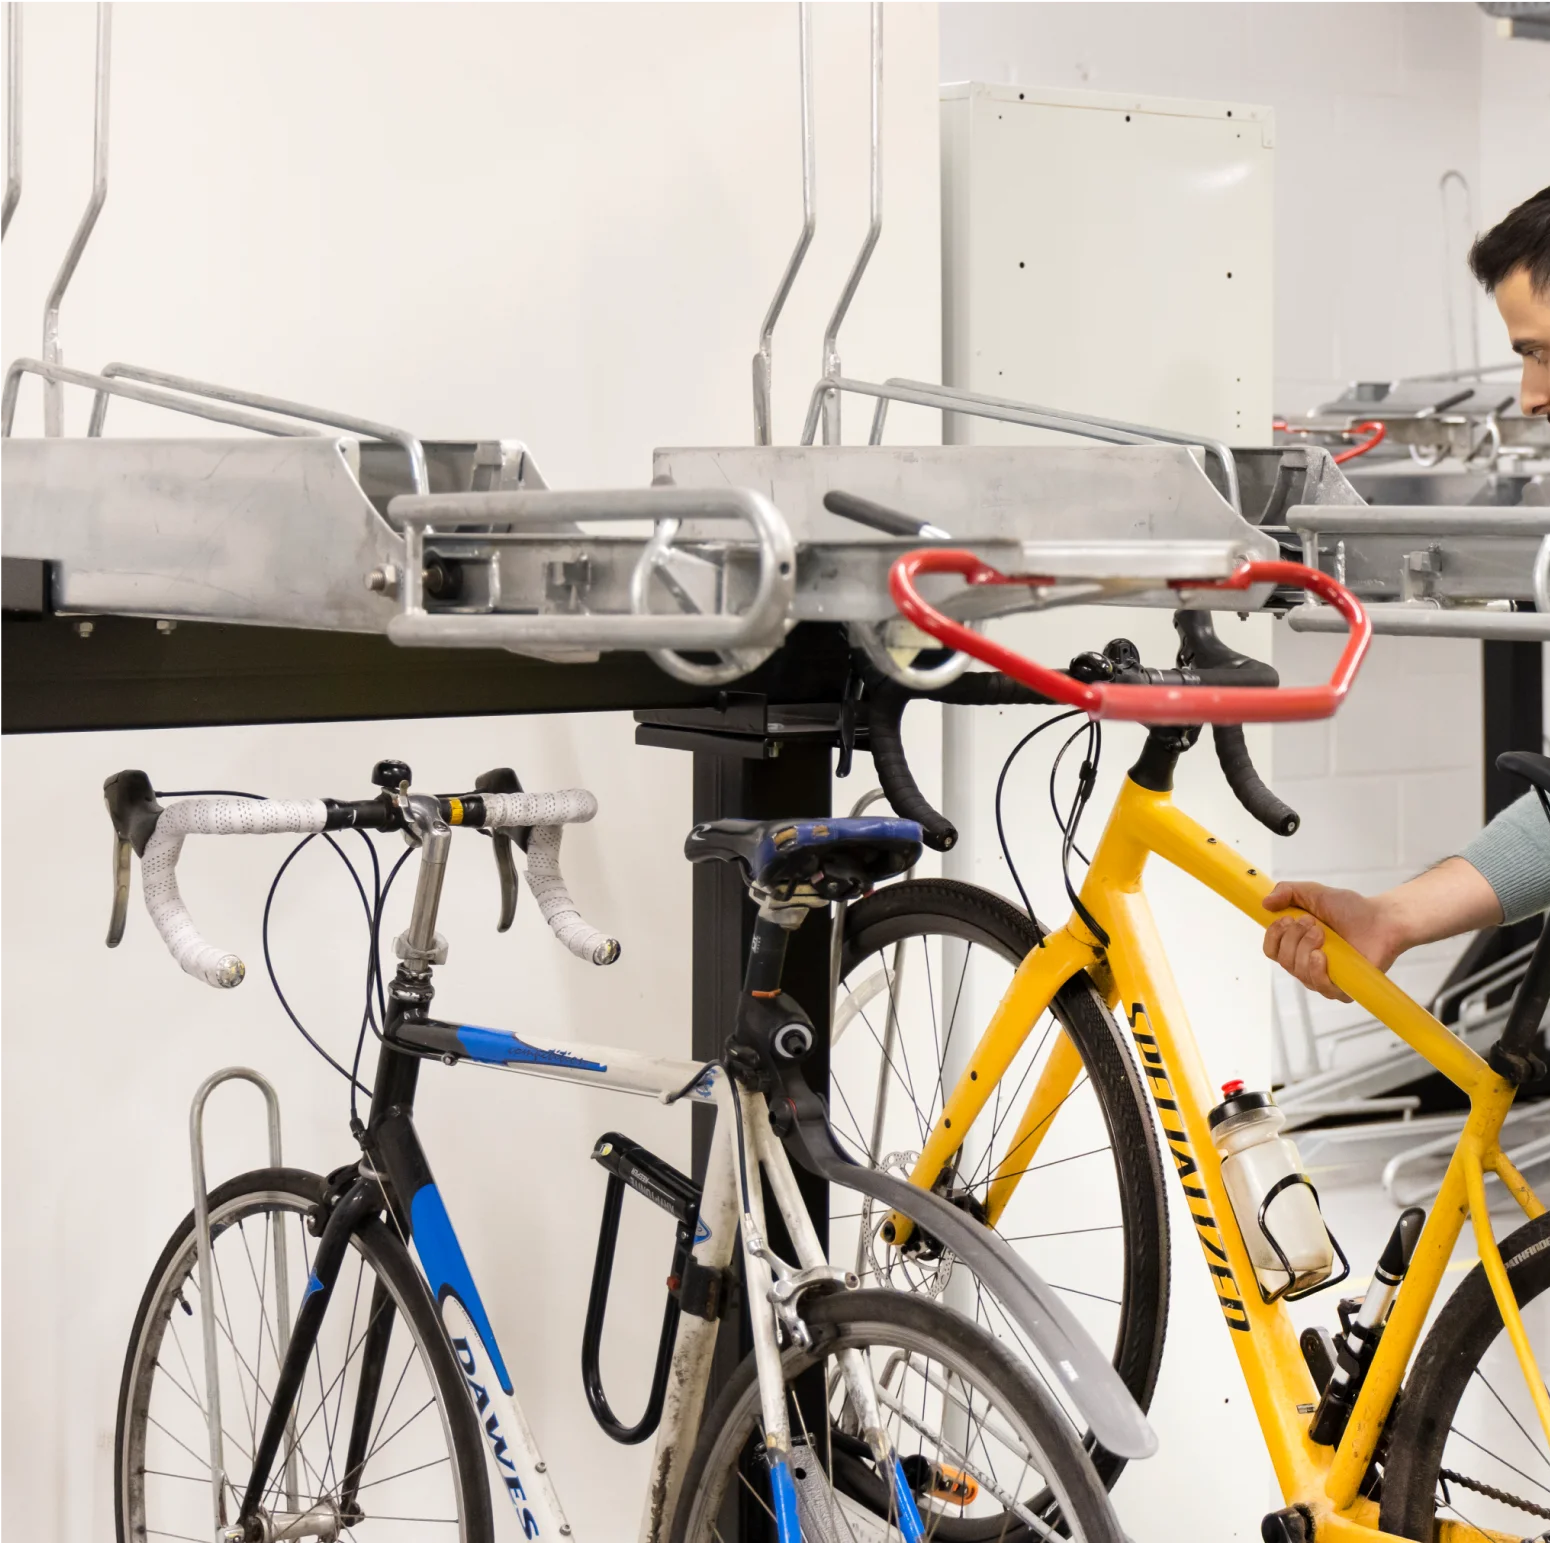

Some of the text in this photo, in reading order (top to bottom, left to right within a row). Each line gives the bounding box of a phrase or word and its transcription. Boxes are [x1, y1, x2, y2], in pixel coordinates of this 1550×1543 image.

[629, 1176, 676, 1214] KRYPTONITE
[631, 1167, 650, 1184] KEEPER
[1127, 1001, 1250, 1332] SPECIALIZED
[451, 1336, 540, 1541] DAWES
